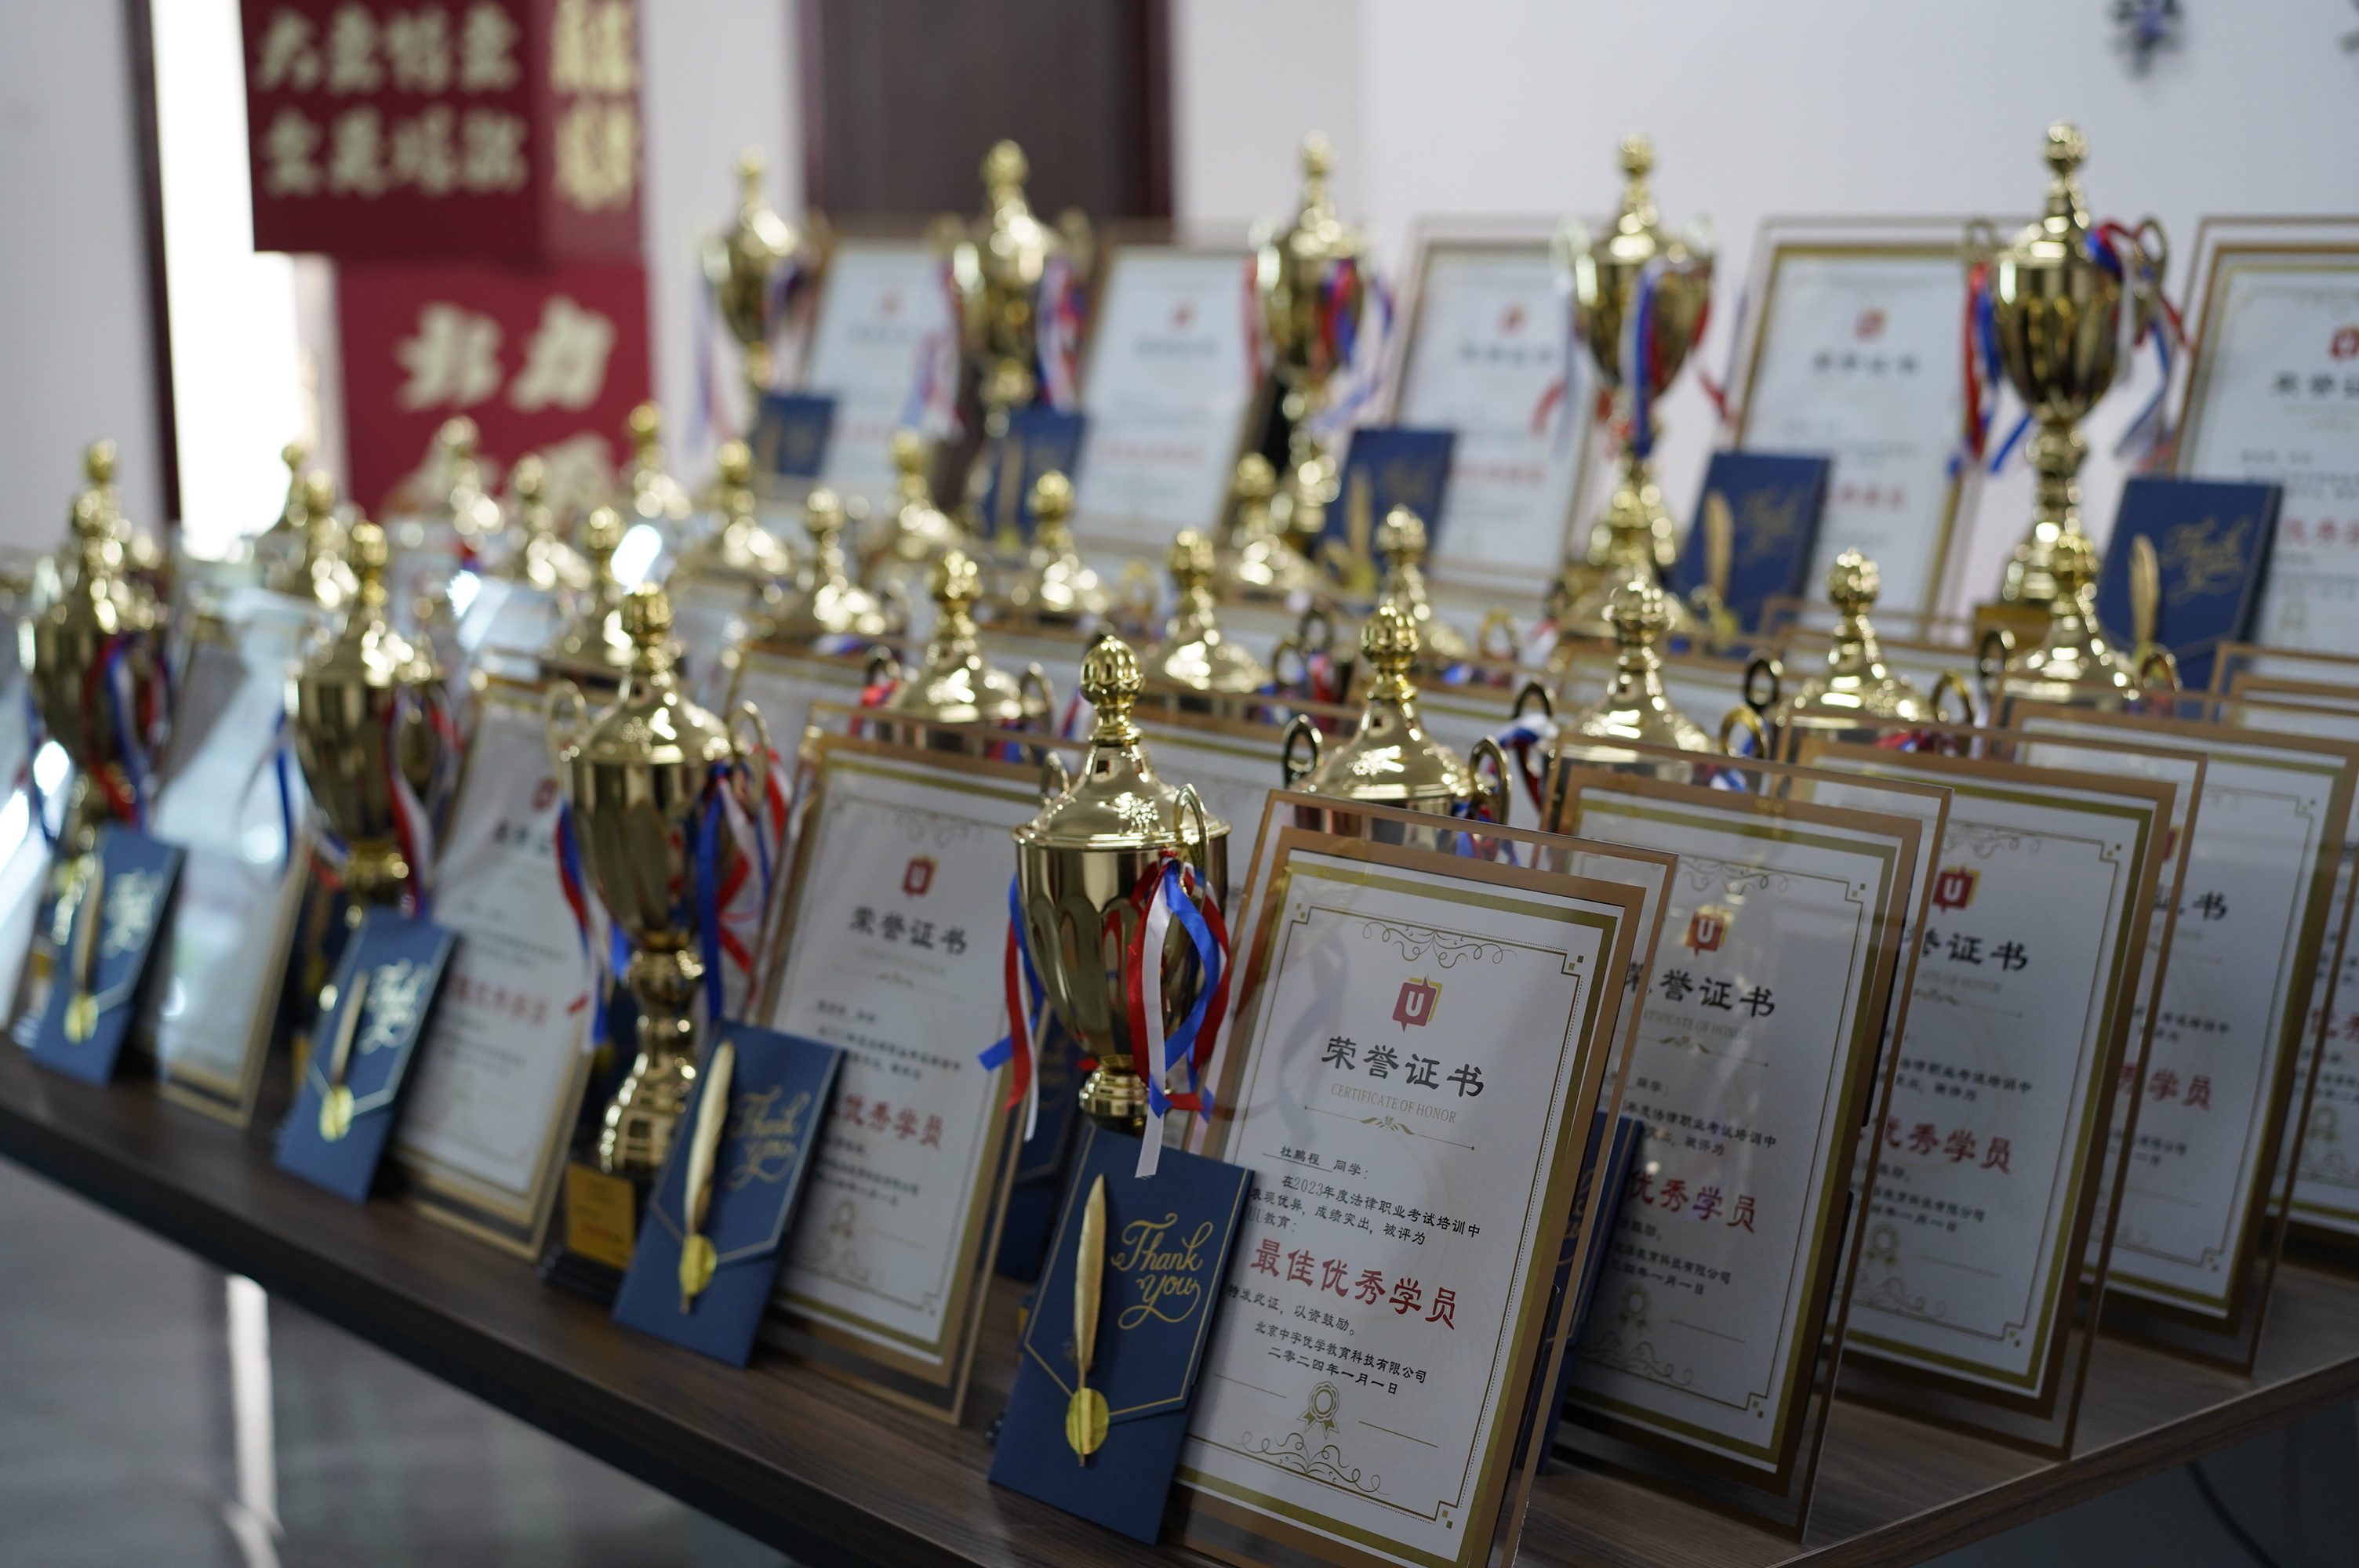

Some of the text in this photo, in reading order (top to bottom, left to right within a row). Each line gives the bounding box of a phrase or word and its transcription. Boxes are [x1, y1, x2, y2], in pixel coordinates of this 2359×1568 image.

[1321, 1035, 1485, 1098] 荣誉证书
[1331, 1083, 1457, 1123] CERTIFICATE OF HONOR
[1279, 1145, 1320, 1167] 杜鹏程
[1281, 1175, 1481, 1239] 在2023年度法律职业考试培训中
[1110, 1212, 1213, 1272] Thank
[1250, 1238, 1459, 1330] 最佳优秀学员
[1255, 1320, 1427, 1384] 北京中宇优学教育科技有限公司
[1267, 1346, 1398, 1395] 二零二四年一月一日
